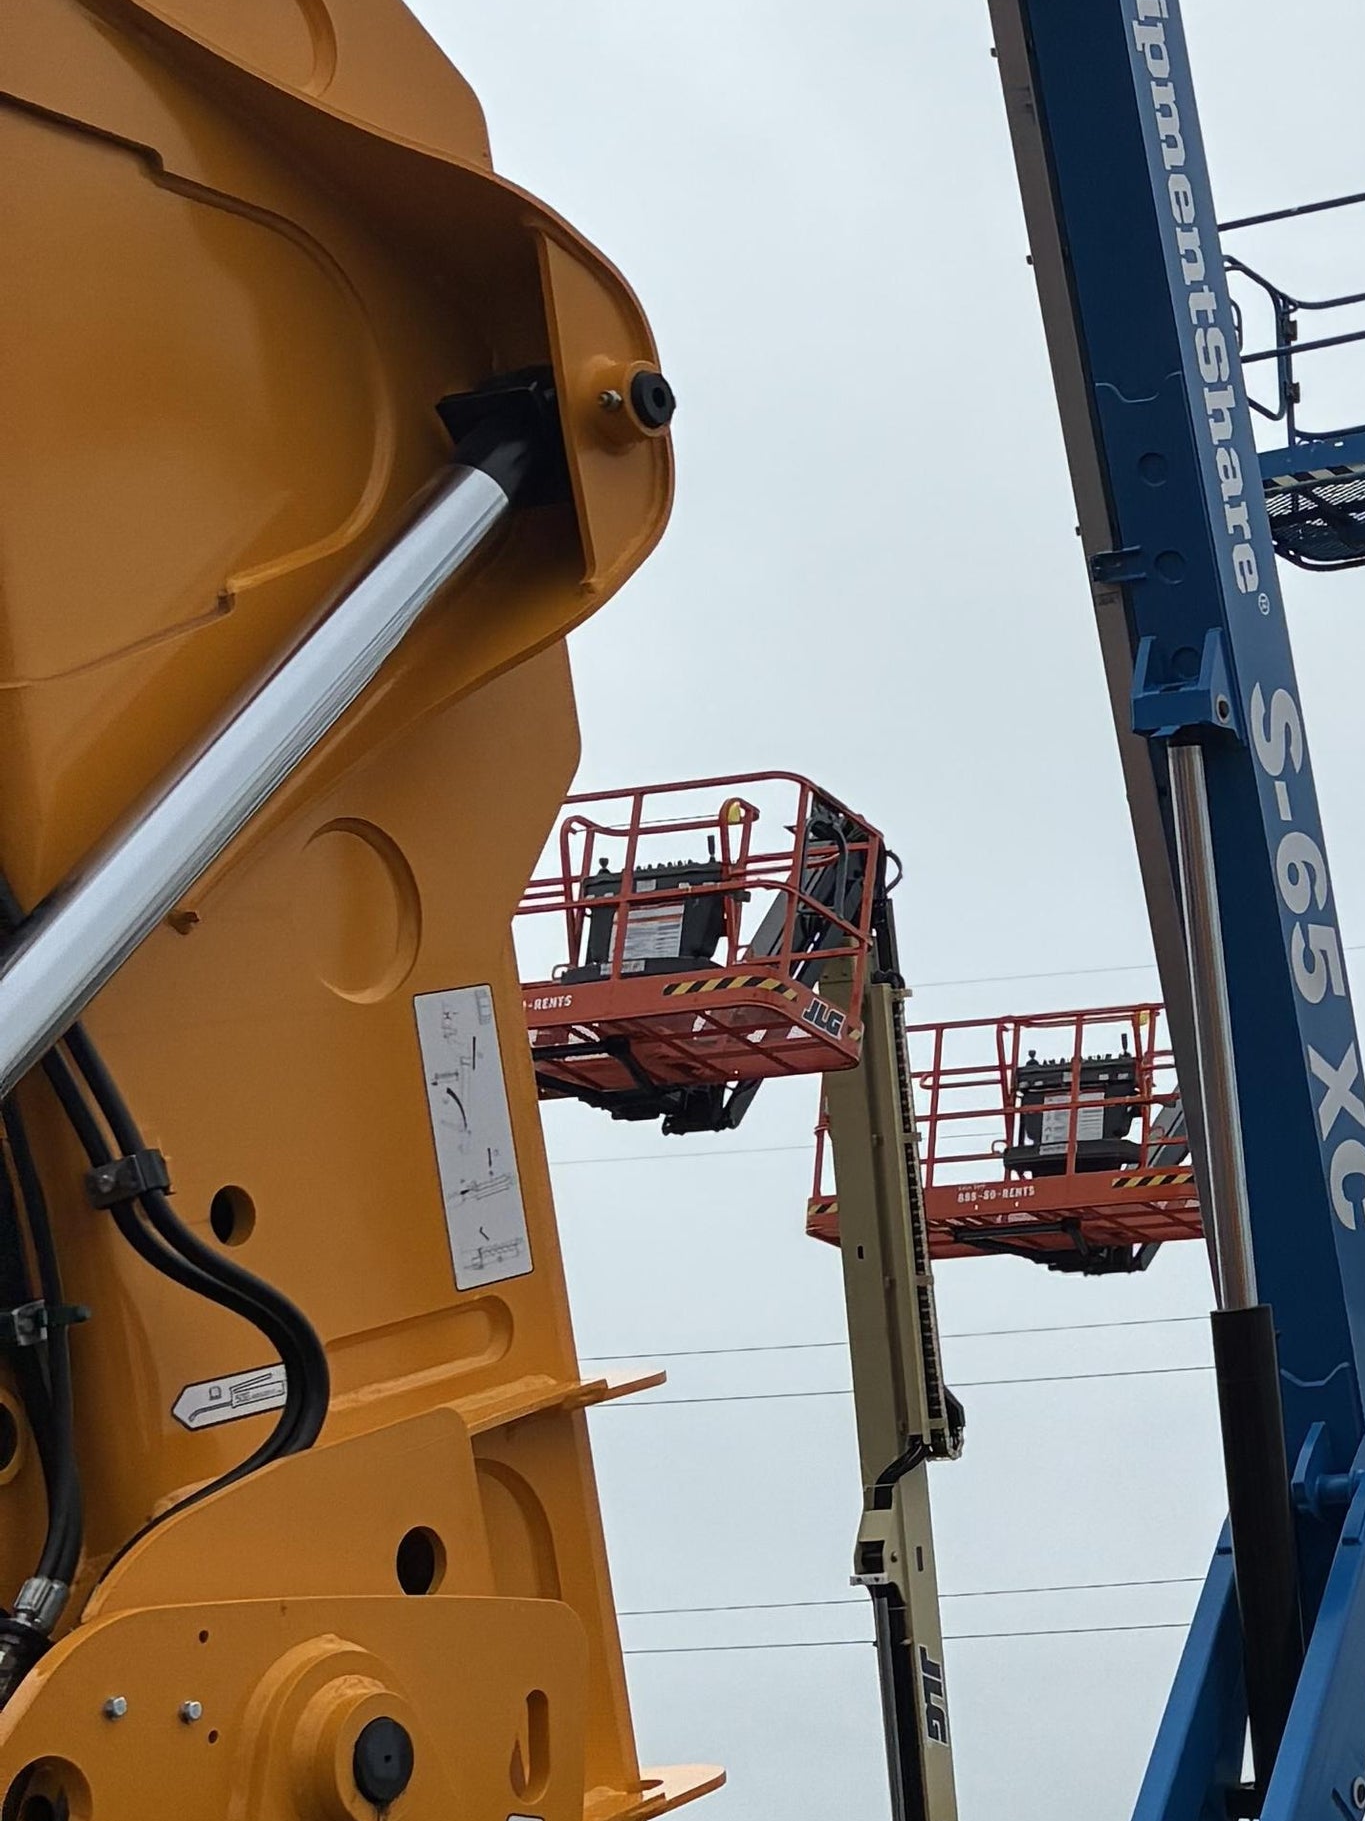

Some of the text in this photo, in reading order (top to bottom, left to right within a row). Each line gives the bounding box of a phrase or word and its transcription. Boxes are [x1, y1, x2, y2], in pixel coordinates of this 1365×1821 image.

[1249, 680, 1346, 1005] S-65
[523, 994, 573, 1010] -RENTS
[802, 998, 846, 1038] JLG
[919, 1645, 949, 1744] JLG
